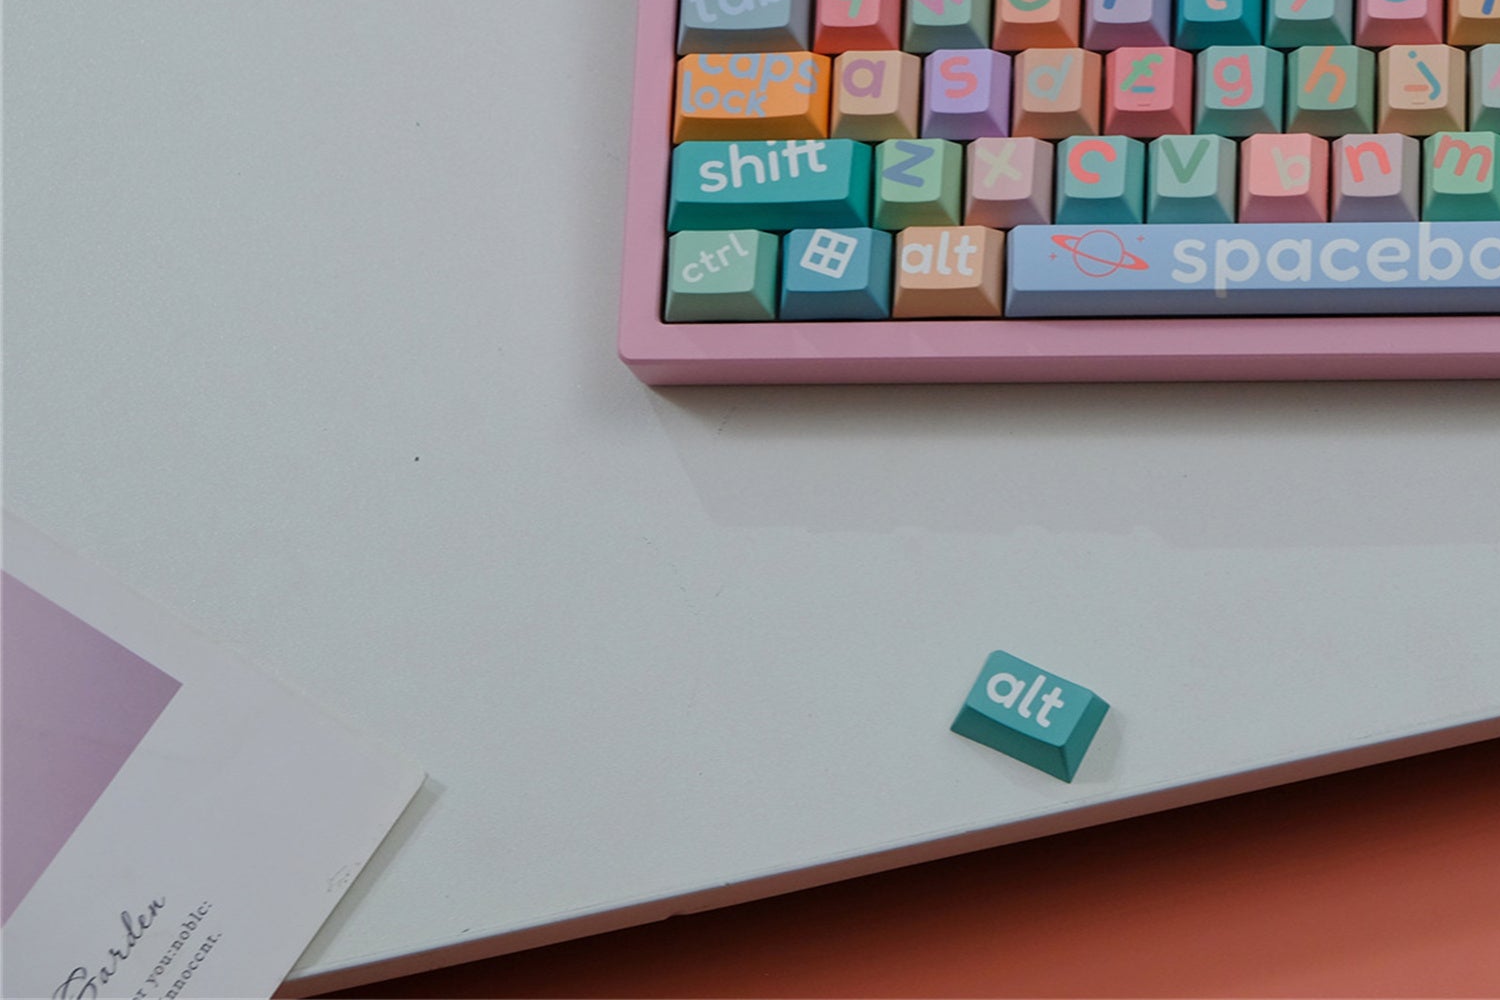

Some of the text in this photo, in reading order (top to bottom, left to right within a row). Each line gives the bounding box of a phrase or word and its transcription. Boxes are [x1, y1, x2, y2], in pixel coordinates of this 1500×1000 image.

[681, 70, 768, 118] lock
[698, 53, 820, 95] caps
[843, 58, 887, 99] a
[940, 56, 978, 98] s
[1027, 54, 1074, 101] d
[1120, 54, 1163, 91] f
[1213, 54, 1253, 107] g
[1304, 46, 1346, 103] h
[1407, 50, 1441, 101] j
[700, 138, 828, 193] shift
[681, 233, 749, 284] ctrl
[901, 231, 977, 276] alt
[986, 672, 1065, 728] alt
